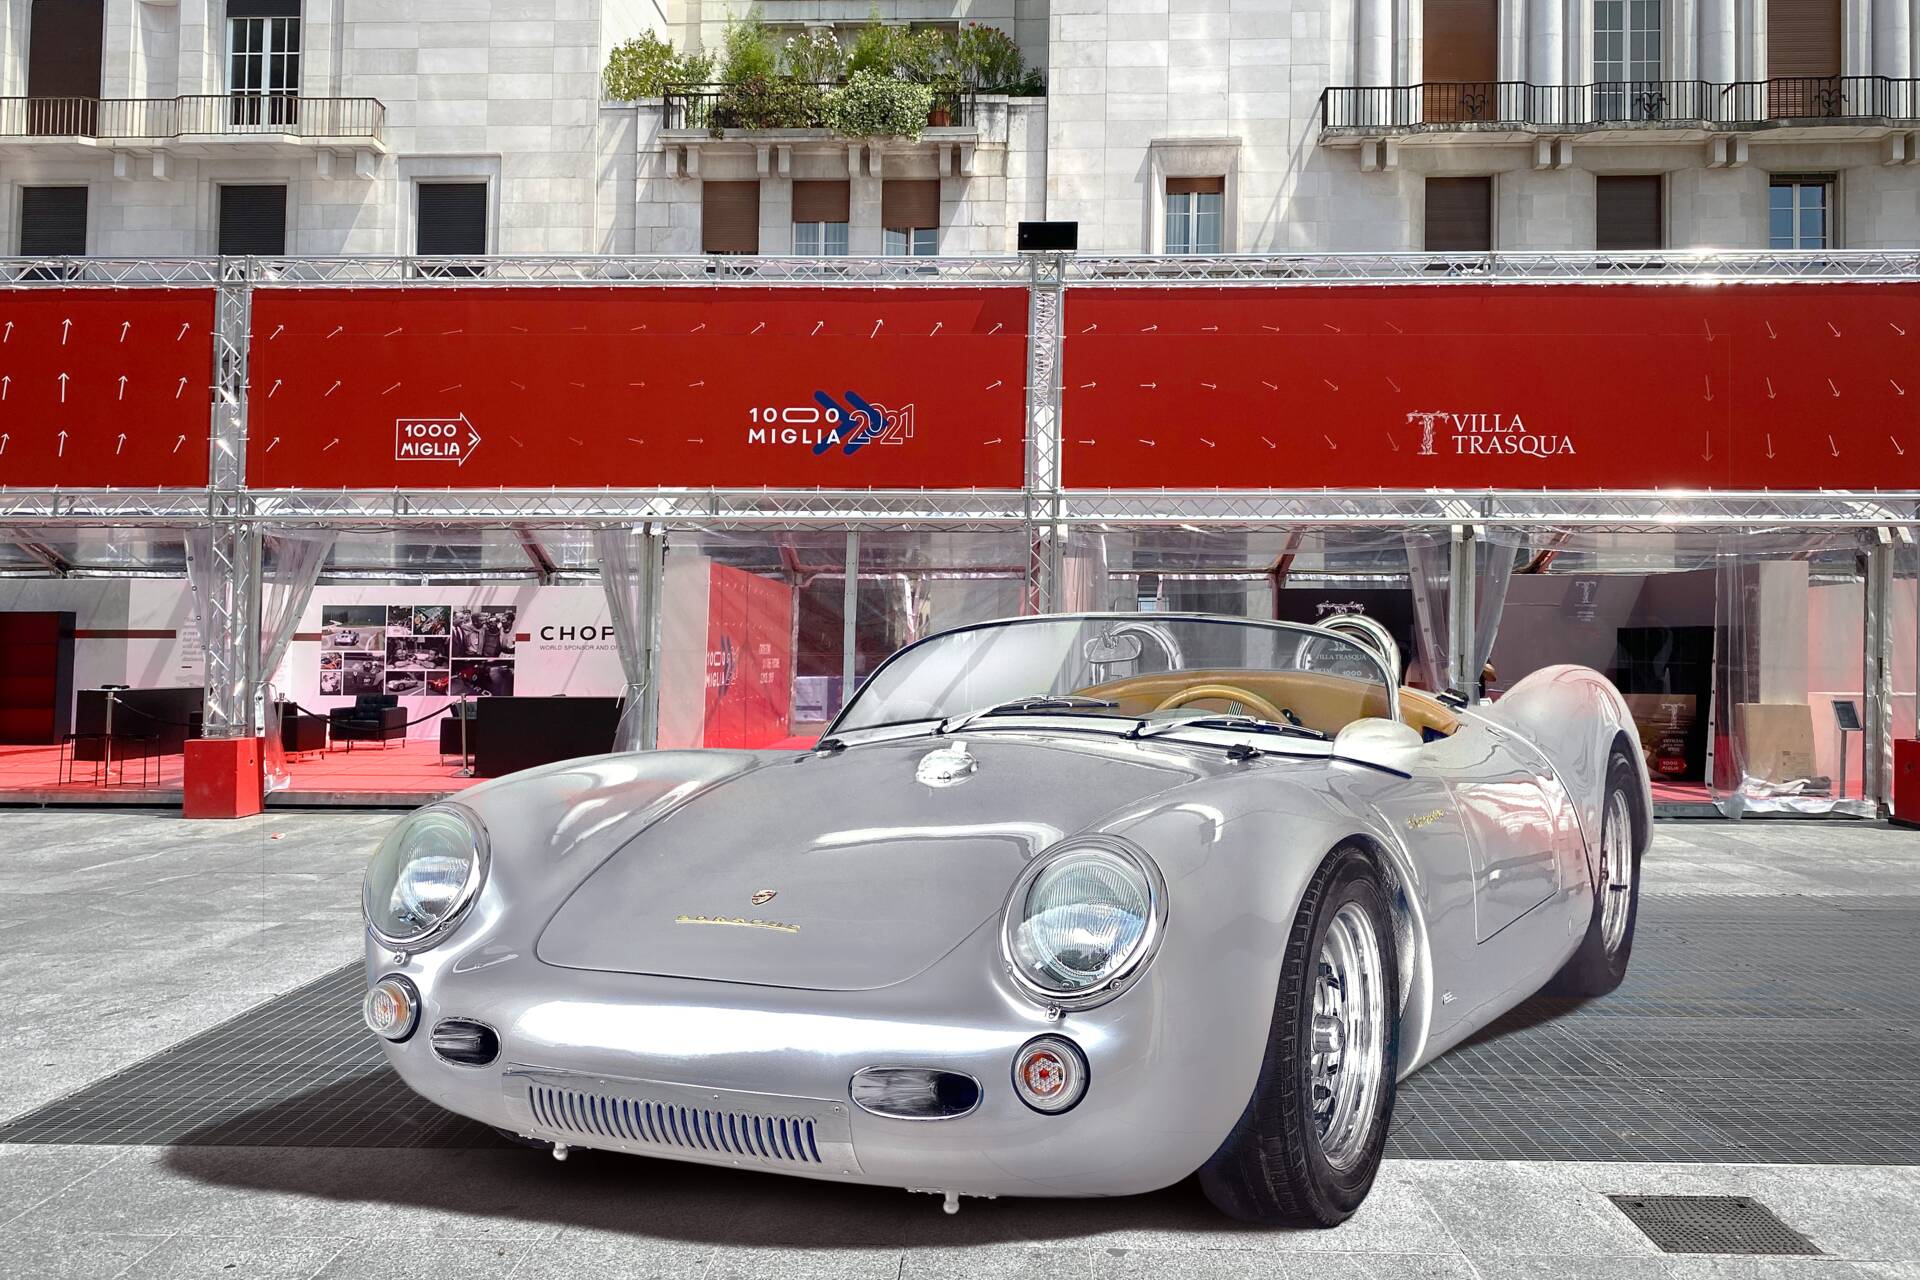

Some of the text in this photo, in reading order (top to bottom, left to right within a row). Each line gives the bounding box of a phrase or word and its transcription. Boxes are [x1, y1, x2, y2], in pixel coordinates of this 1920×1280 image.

[749, 407, 840, 423] 1000
[1452, 413, 1526, 433] VILLA
[405, 424, 457, 437] 1000
[848, 403, 914, 445] 2021
[748, 428, 841, 444] MIGLIA
[400, 442, 460, 456] MIGLIA
[1452, 435, 1576, 458] TRASQUA
